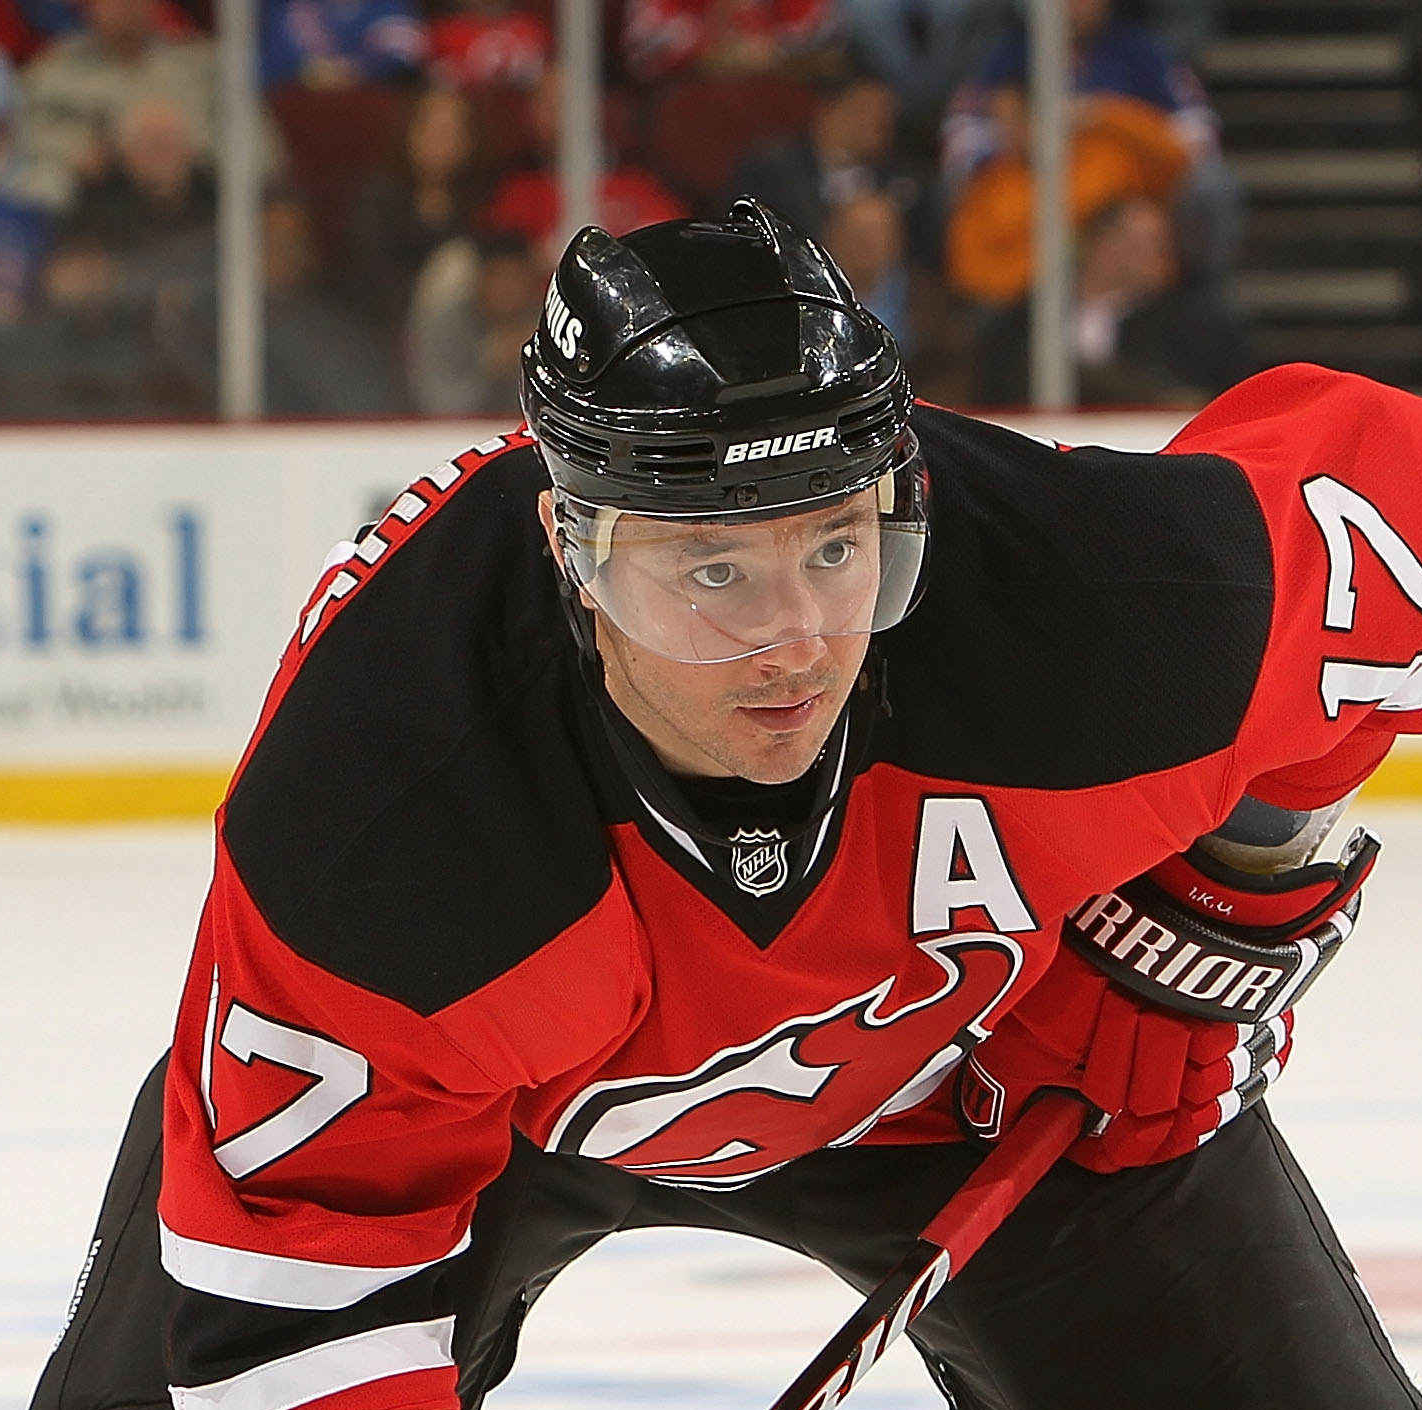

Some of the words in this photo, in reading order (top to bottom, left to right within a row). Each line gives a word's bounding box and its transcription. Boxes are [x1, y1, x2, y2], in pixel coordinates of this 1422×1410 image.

[742, 846, 775, 879] NHL
[911, 796, 1039, 934] A
[1067, 891, 1284, 1011] RRIOR
